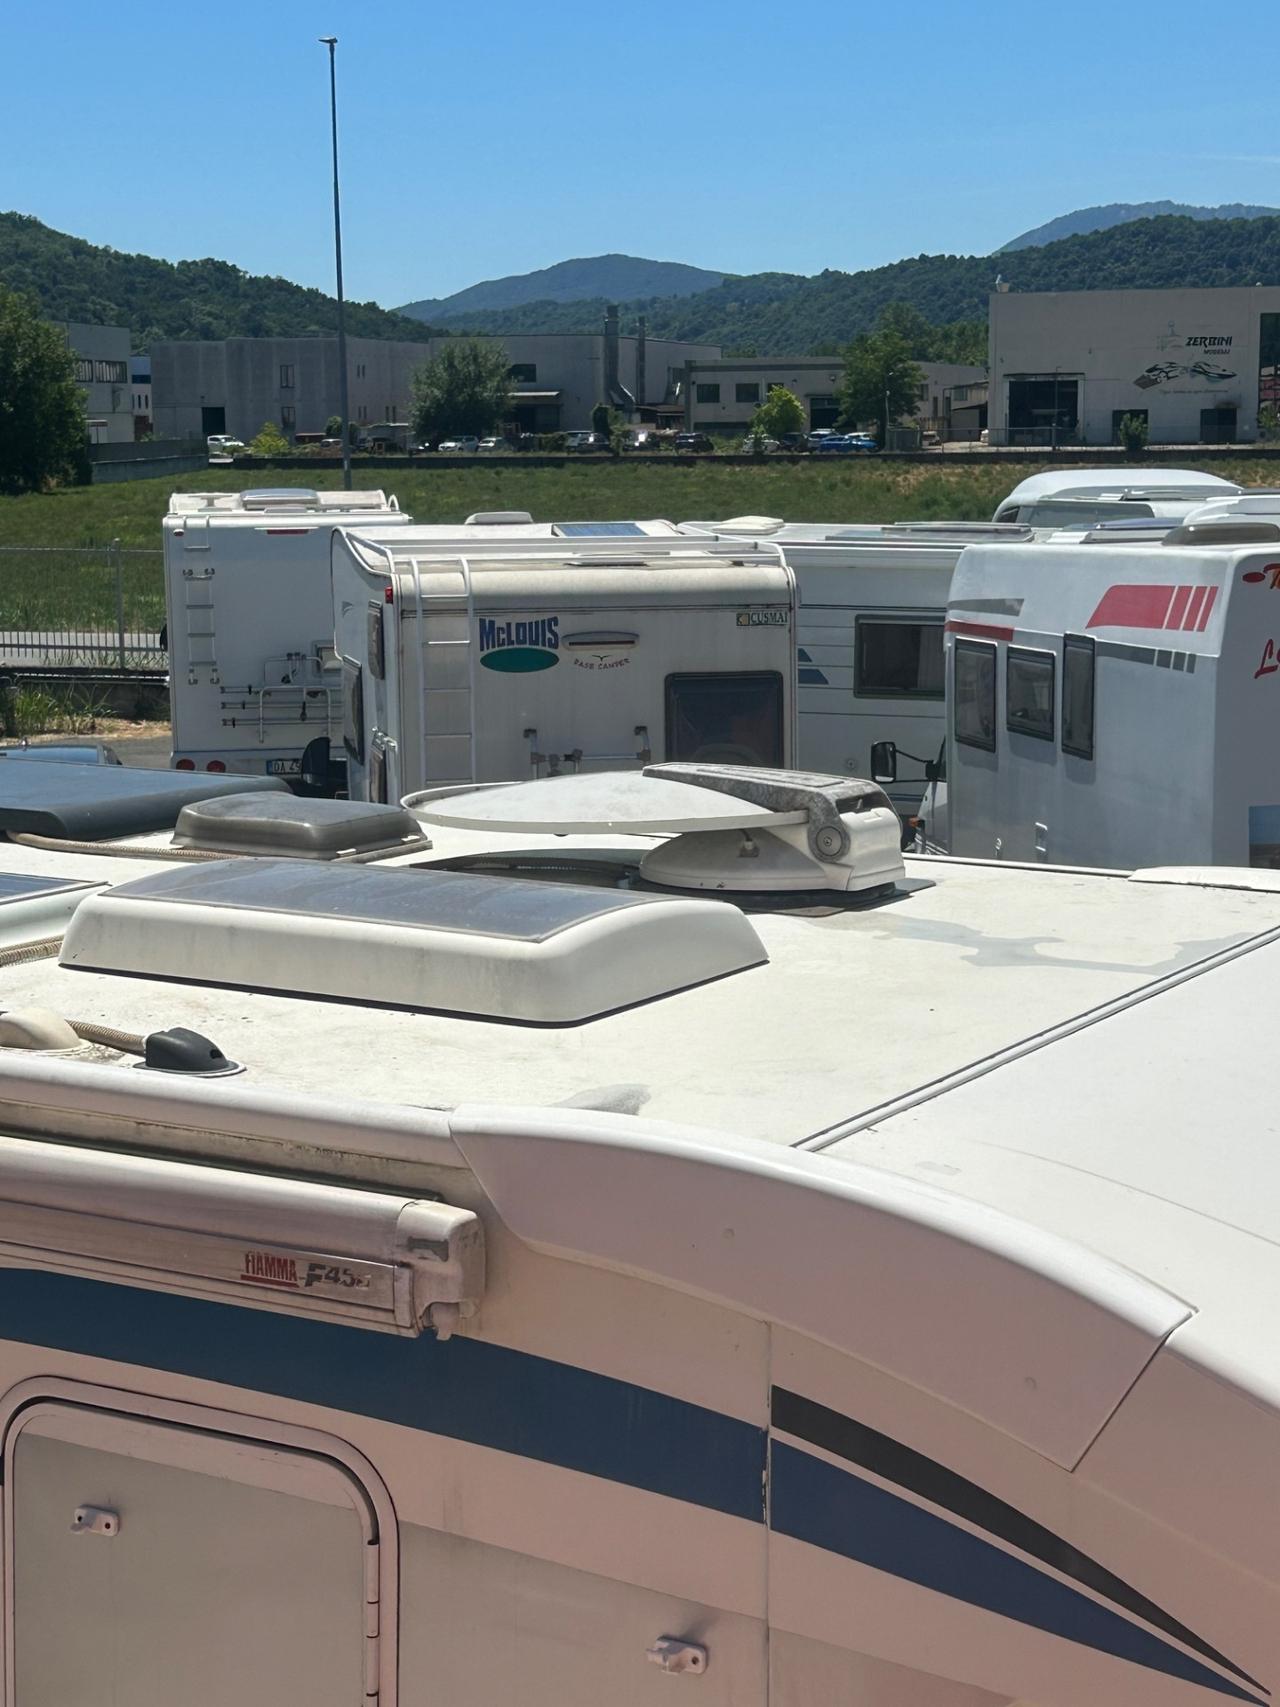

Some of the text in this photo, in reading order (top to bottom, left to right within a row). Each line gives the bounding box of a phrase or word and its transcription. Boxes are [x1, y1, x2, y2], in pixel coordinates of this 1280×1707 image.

[1185, 336, 1233, 348] ZERBINI
[289, 760, 302, 772] 49
[245, 1252, 298, 1282] FIAMMA
